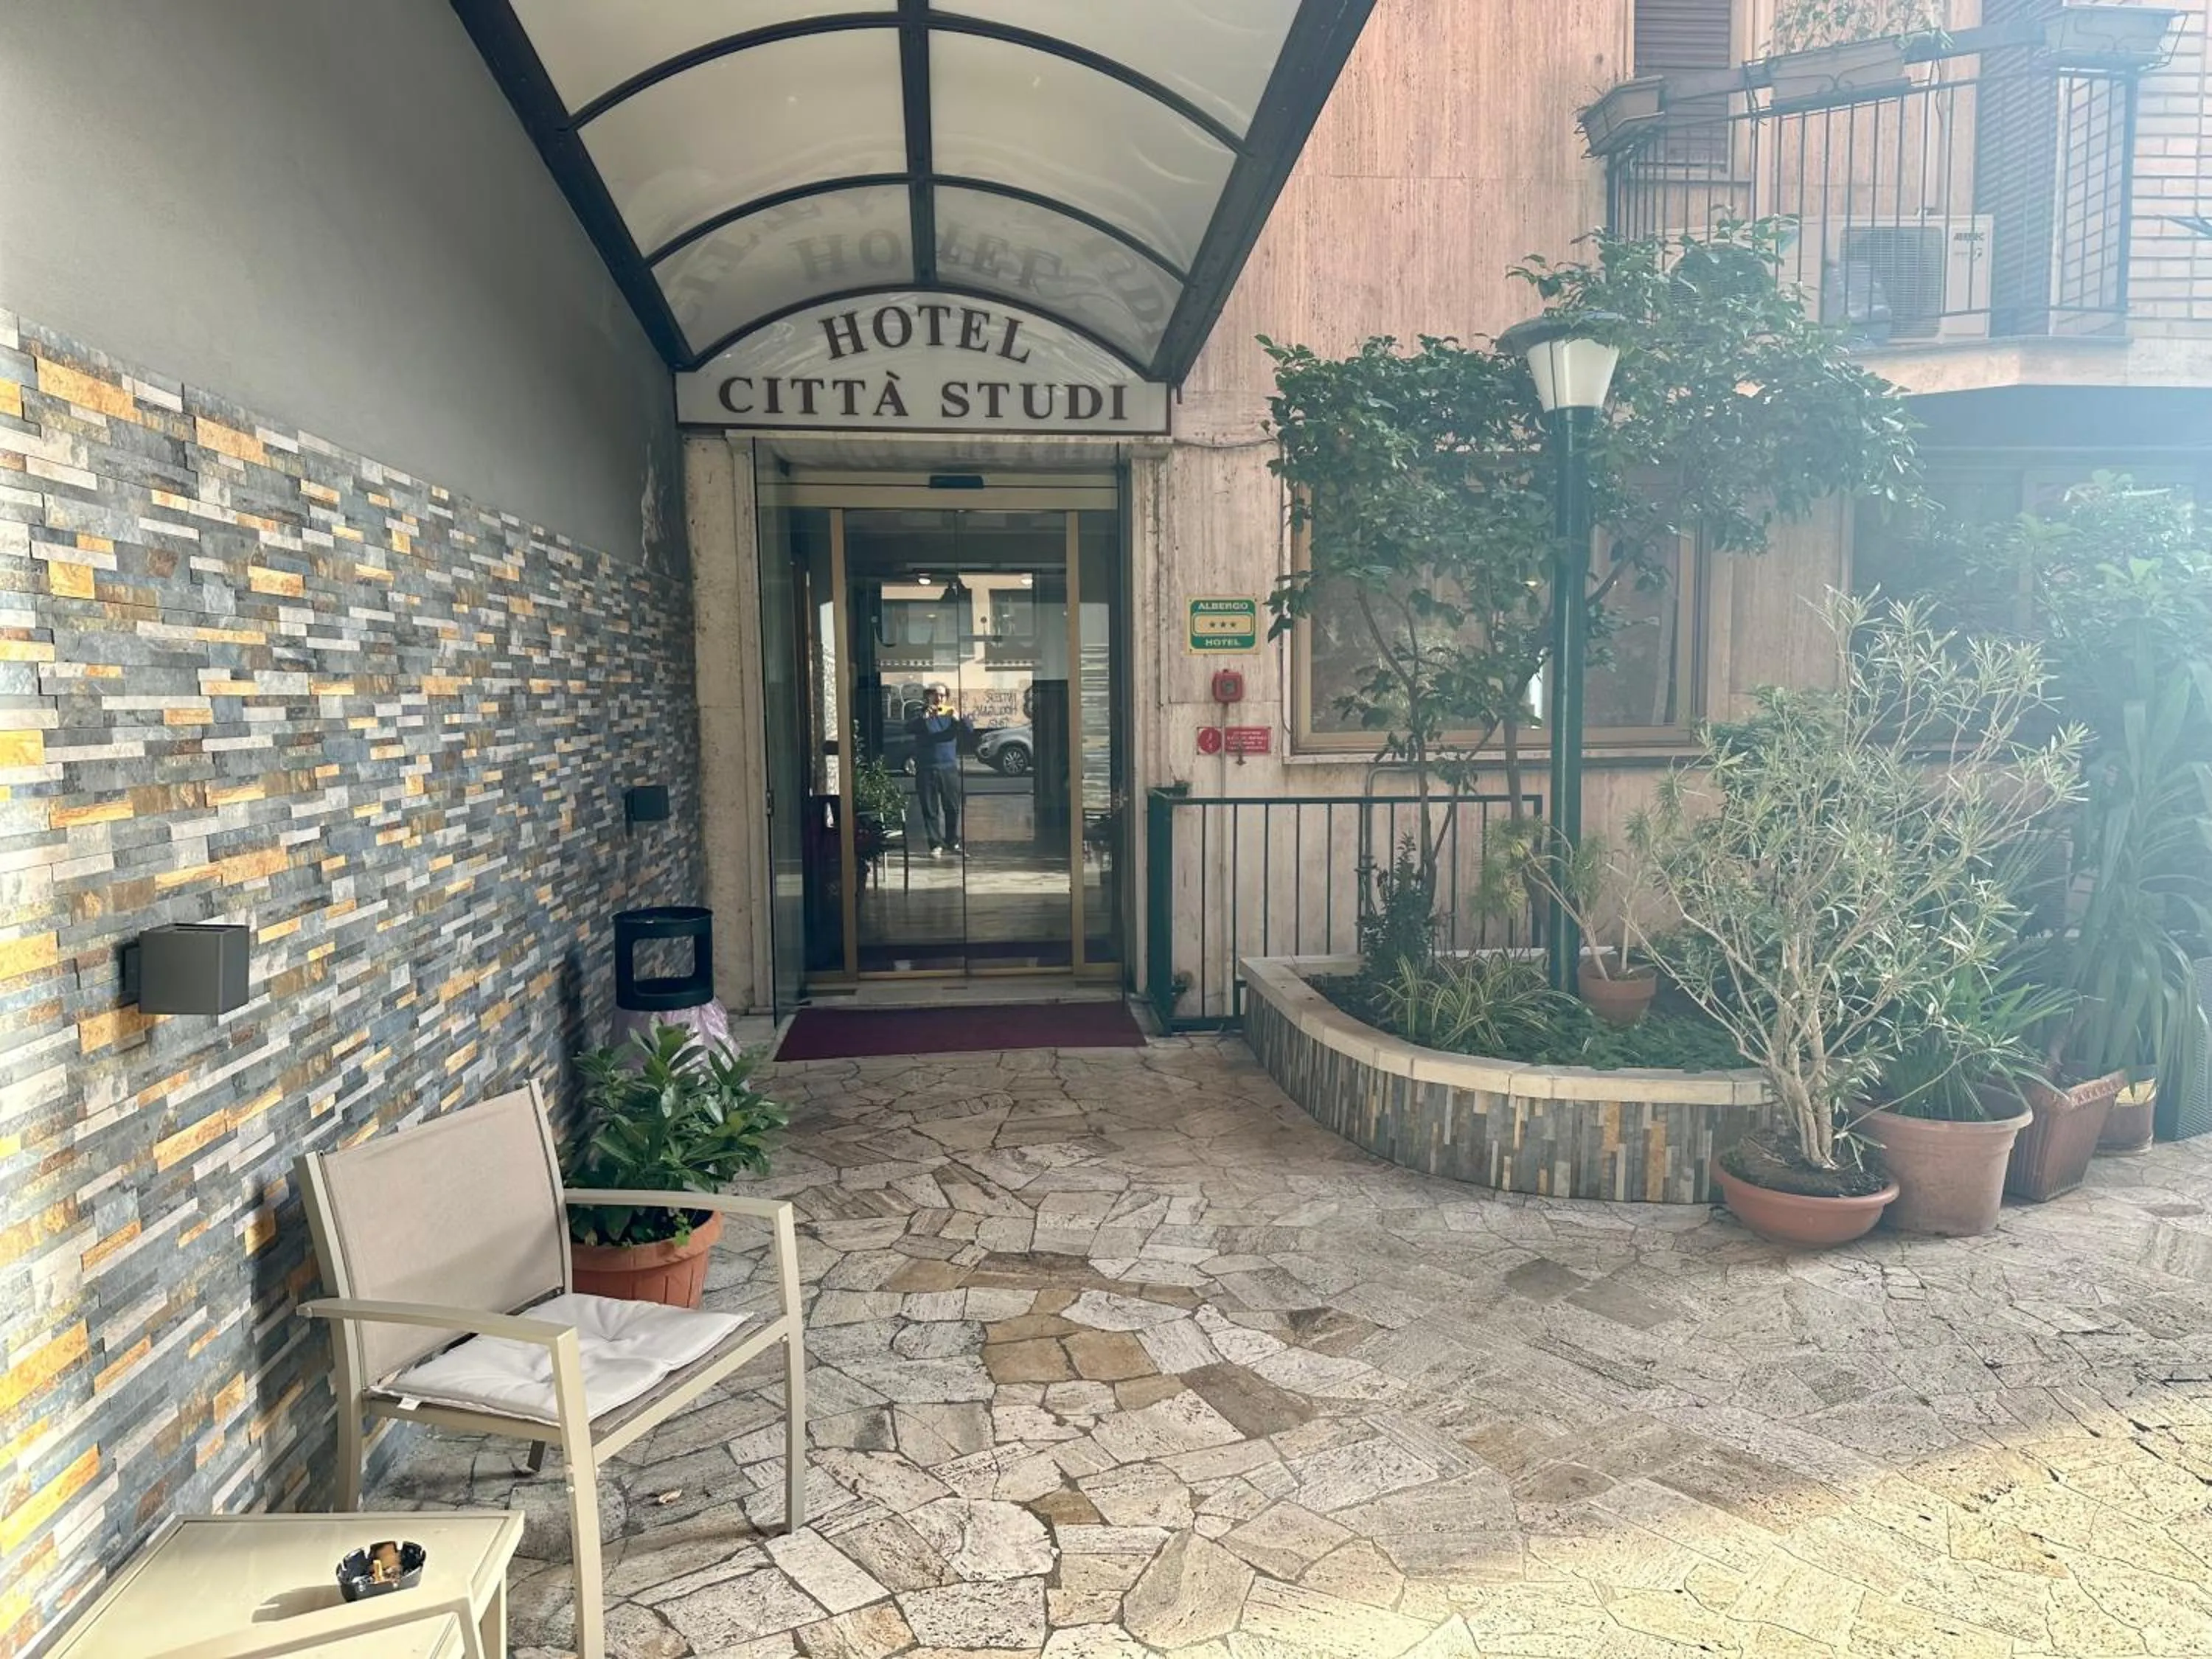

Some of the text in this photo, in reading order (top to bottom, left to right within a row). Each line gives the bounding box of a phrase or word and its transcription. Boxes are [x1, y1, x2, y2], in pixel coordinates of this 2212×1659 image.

[818, 305, 1031, 363] HOTEL
[719, 371, 1129, 421] CITTÀ STUDI
[1198, 602, 1248, 610] ALBERGO
[1206, 639, 1240, 647] HOTEL
